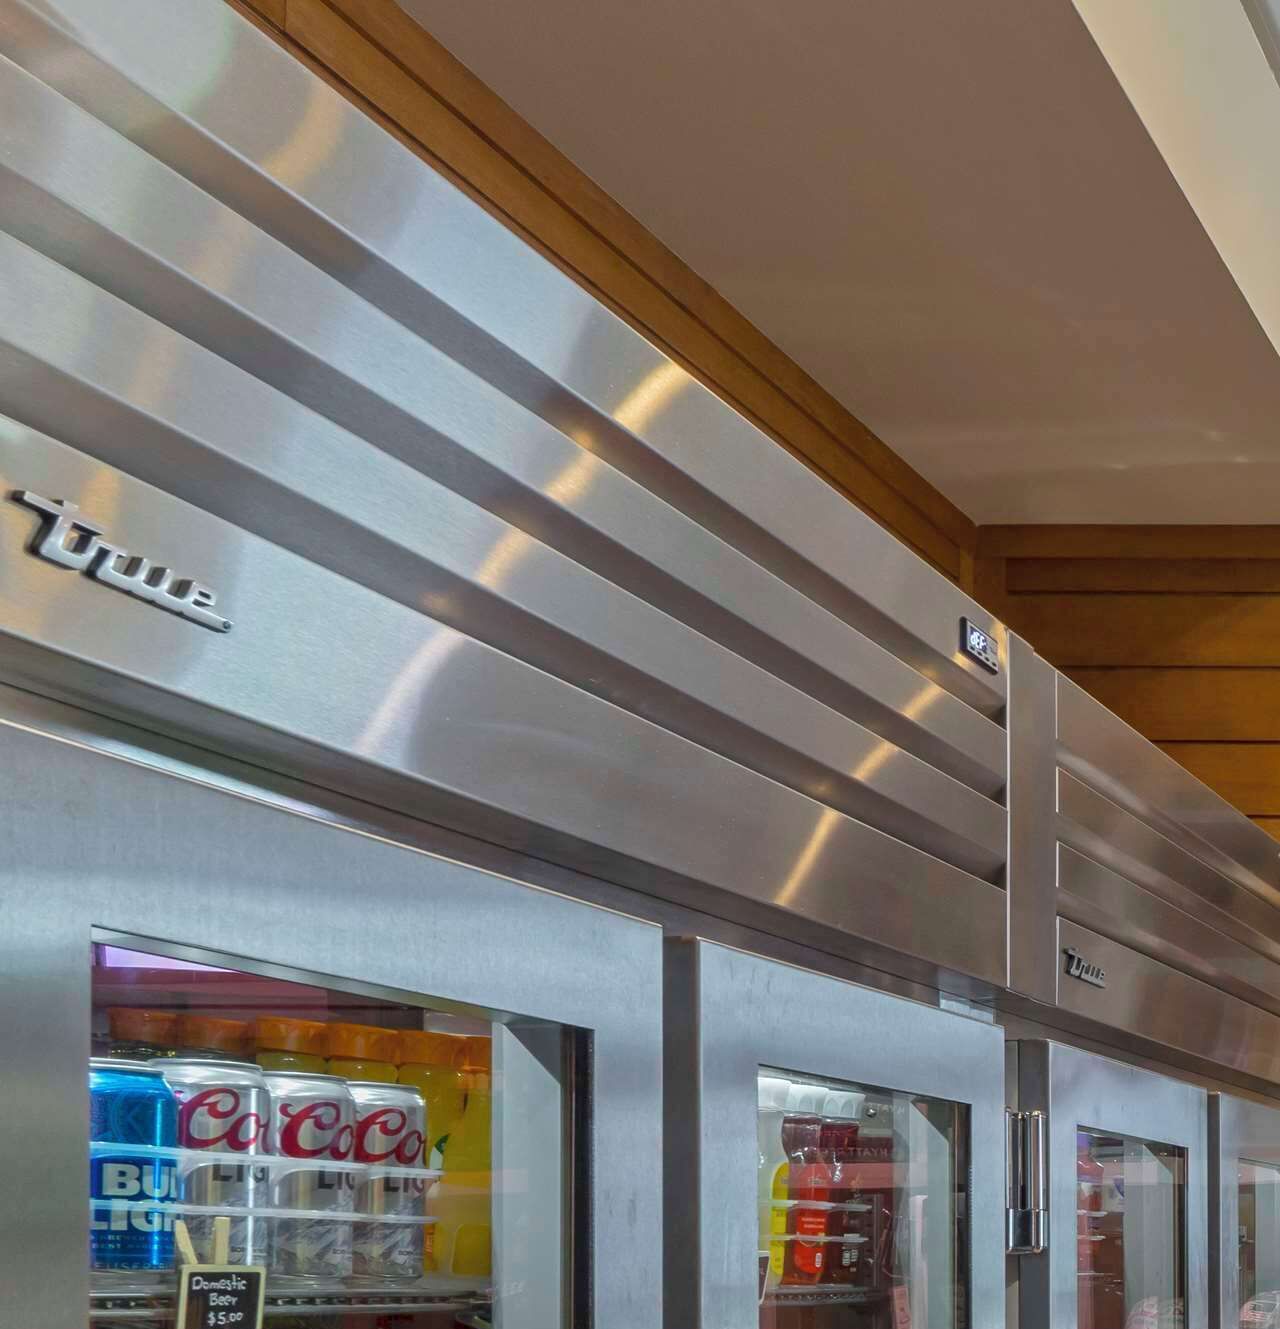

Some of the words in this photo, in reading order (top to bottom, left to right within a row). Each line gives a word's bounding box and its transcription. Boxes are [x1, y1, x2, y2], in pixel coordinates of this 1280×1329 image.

[102, 1163, 177, 1196] BU
[191, 1273, 248, 1291] Domestic
[209, 1292, 239, 1306] Beer
[207, 1311, 245, 1327] $5.00
